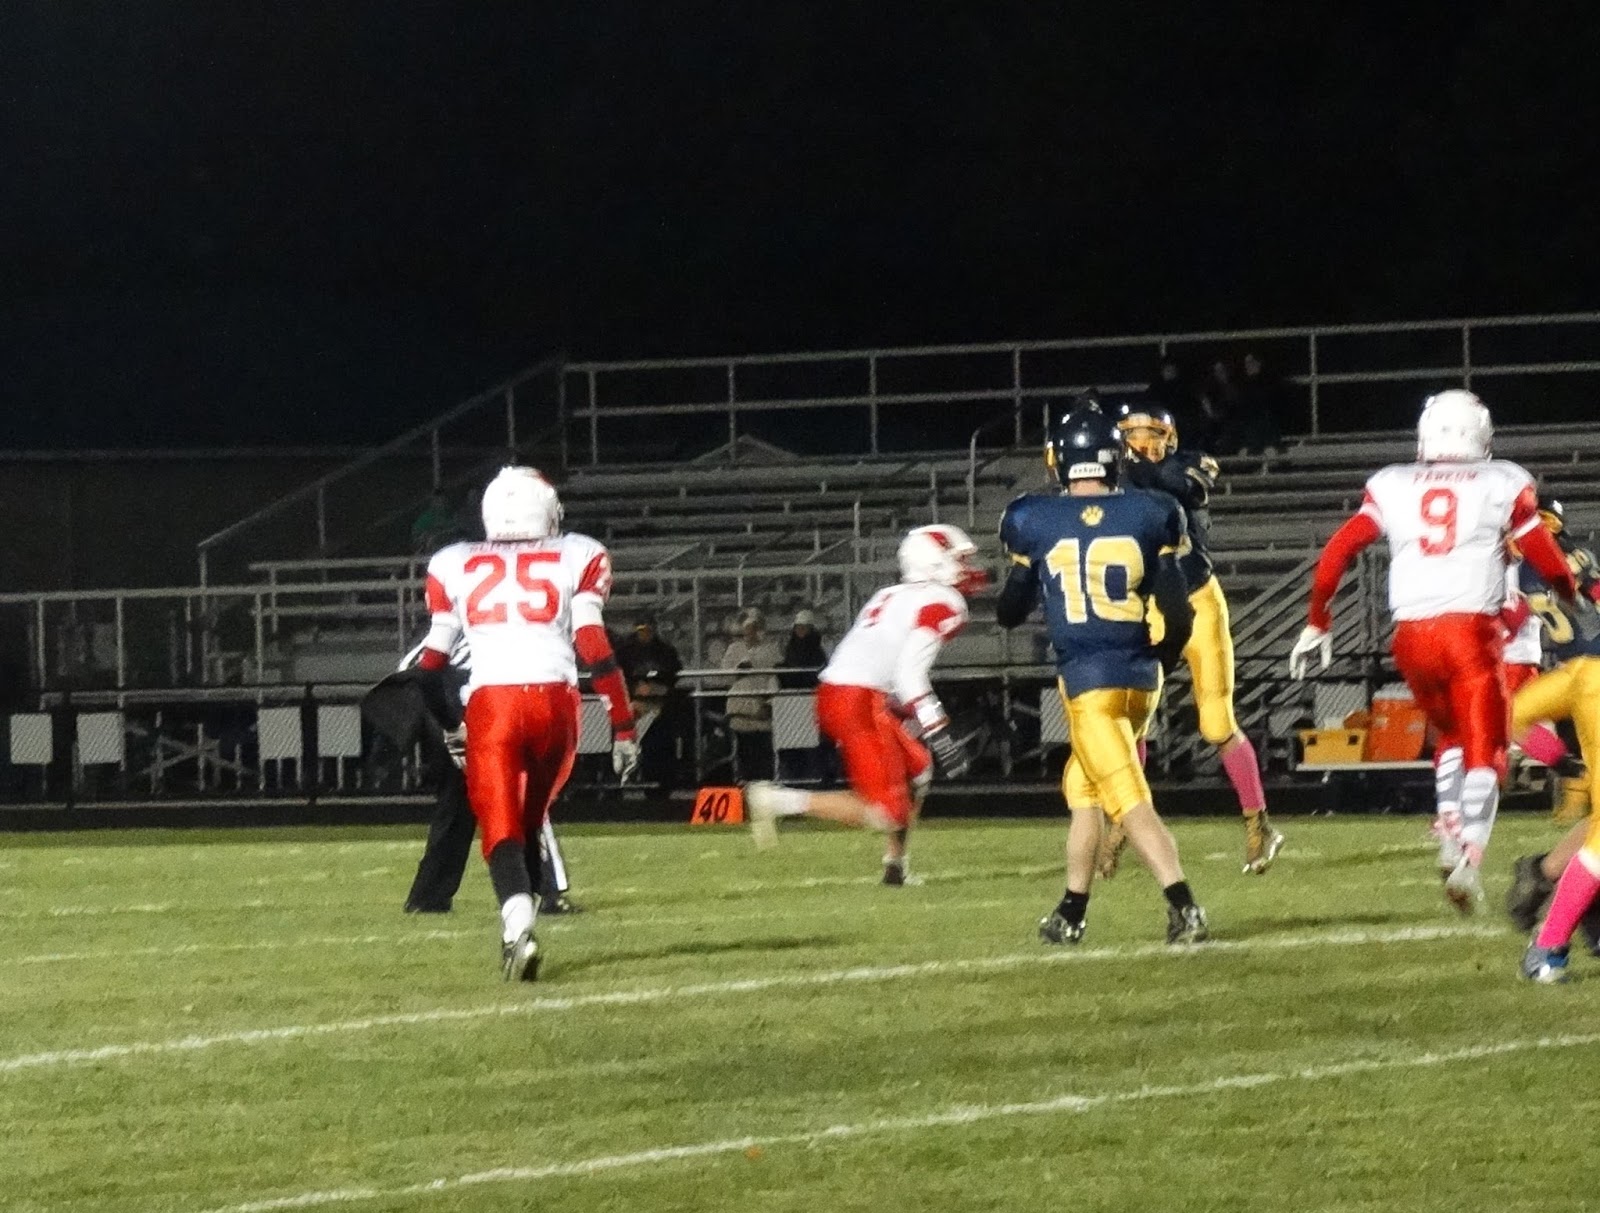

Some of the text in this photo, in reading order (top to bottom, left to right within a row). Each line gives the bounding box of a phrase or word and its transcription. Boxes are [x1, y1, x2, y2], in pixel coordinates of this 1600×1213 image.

[1420, 488, 1458, 556] 9
[464, 552, 561, 626] 25
[1045, 536, 1144, 623] 10
[700, 792, 730, 822] 40
